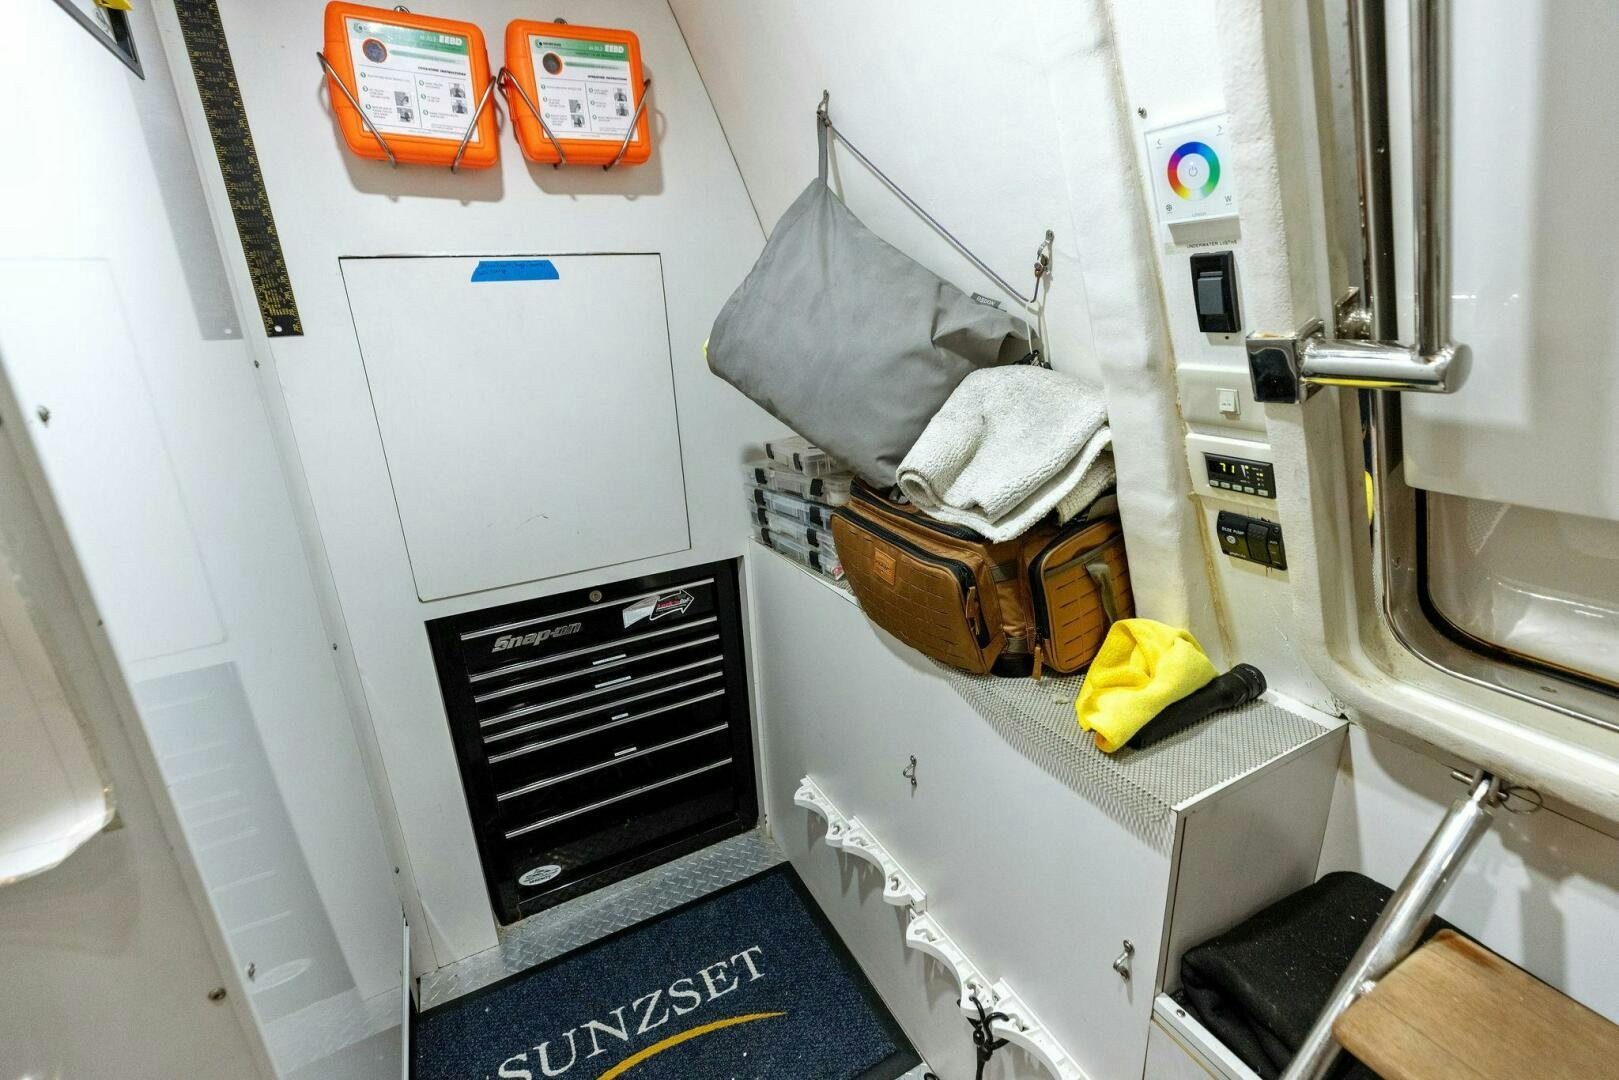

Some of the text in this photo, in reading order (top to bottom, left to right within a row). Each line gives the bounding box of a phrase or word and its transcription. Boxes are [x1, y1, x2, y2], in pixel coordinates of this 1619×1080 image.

[438, 35, 463, 46] EEBD
[604, 44, 624, 53] EEBD
[491, 622, 582, 653] Snap-on
[498, 945, 765, 1080] SUNZSET
